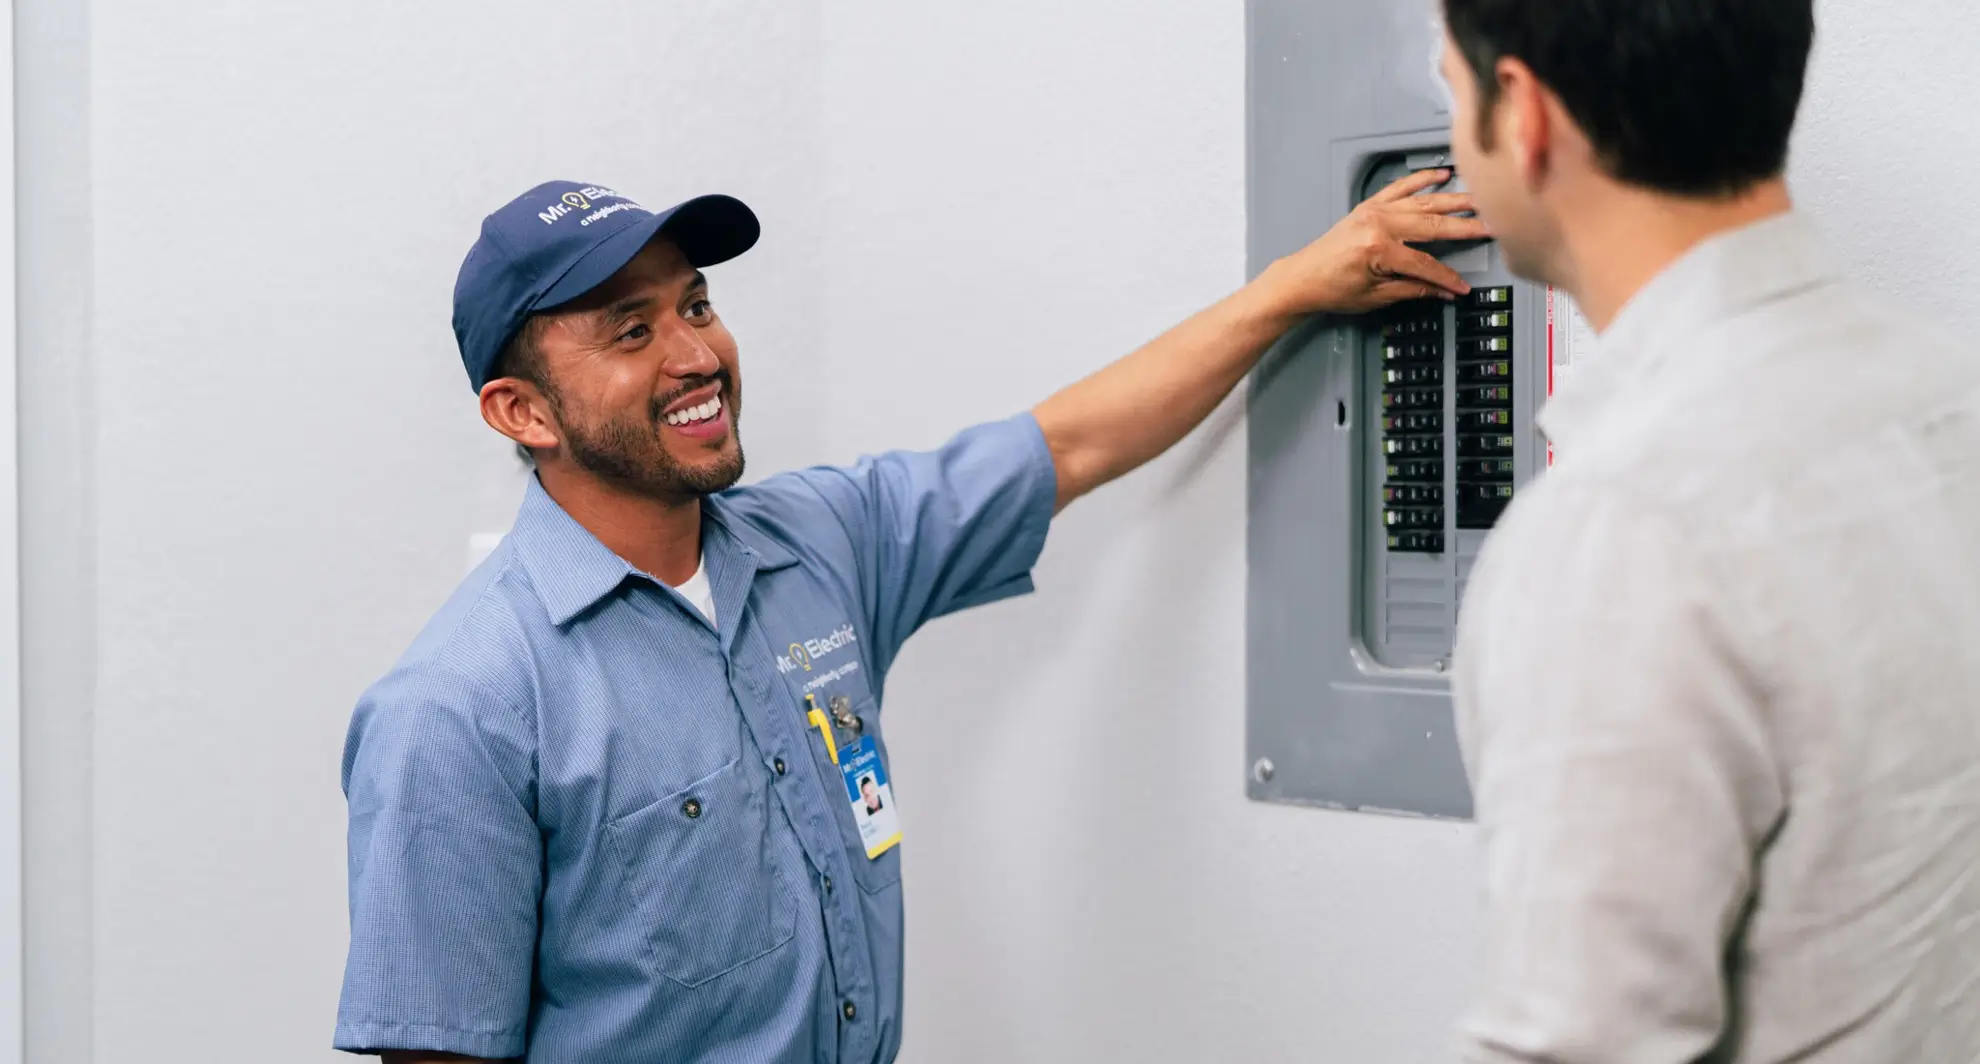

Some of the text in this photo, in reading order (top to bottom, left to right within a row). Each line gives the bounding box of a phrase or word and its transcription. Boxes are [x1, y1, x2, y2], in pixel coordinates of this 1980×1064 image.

[538, 203, 572, 225] Mr.
[580, 219, 589, 227] a
[804, 623, 857, 660] Electric
